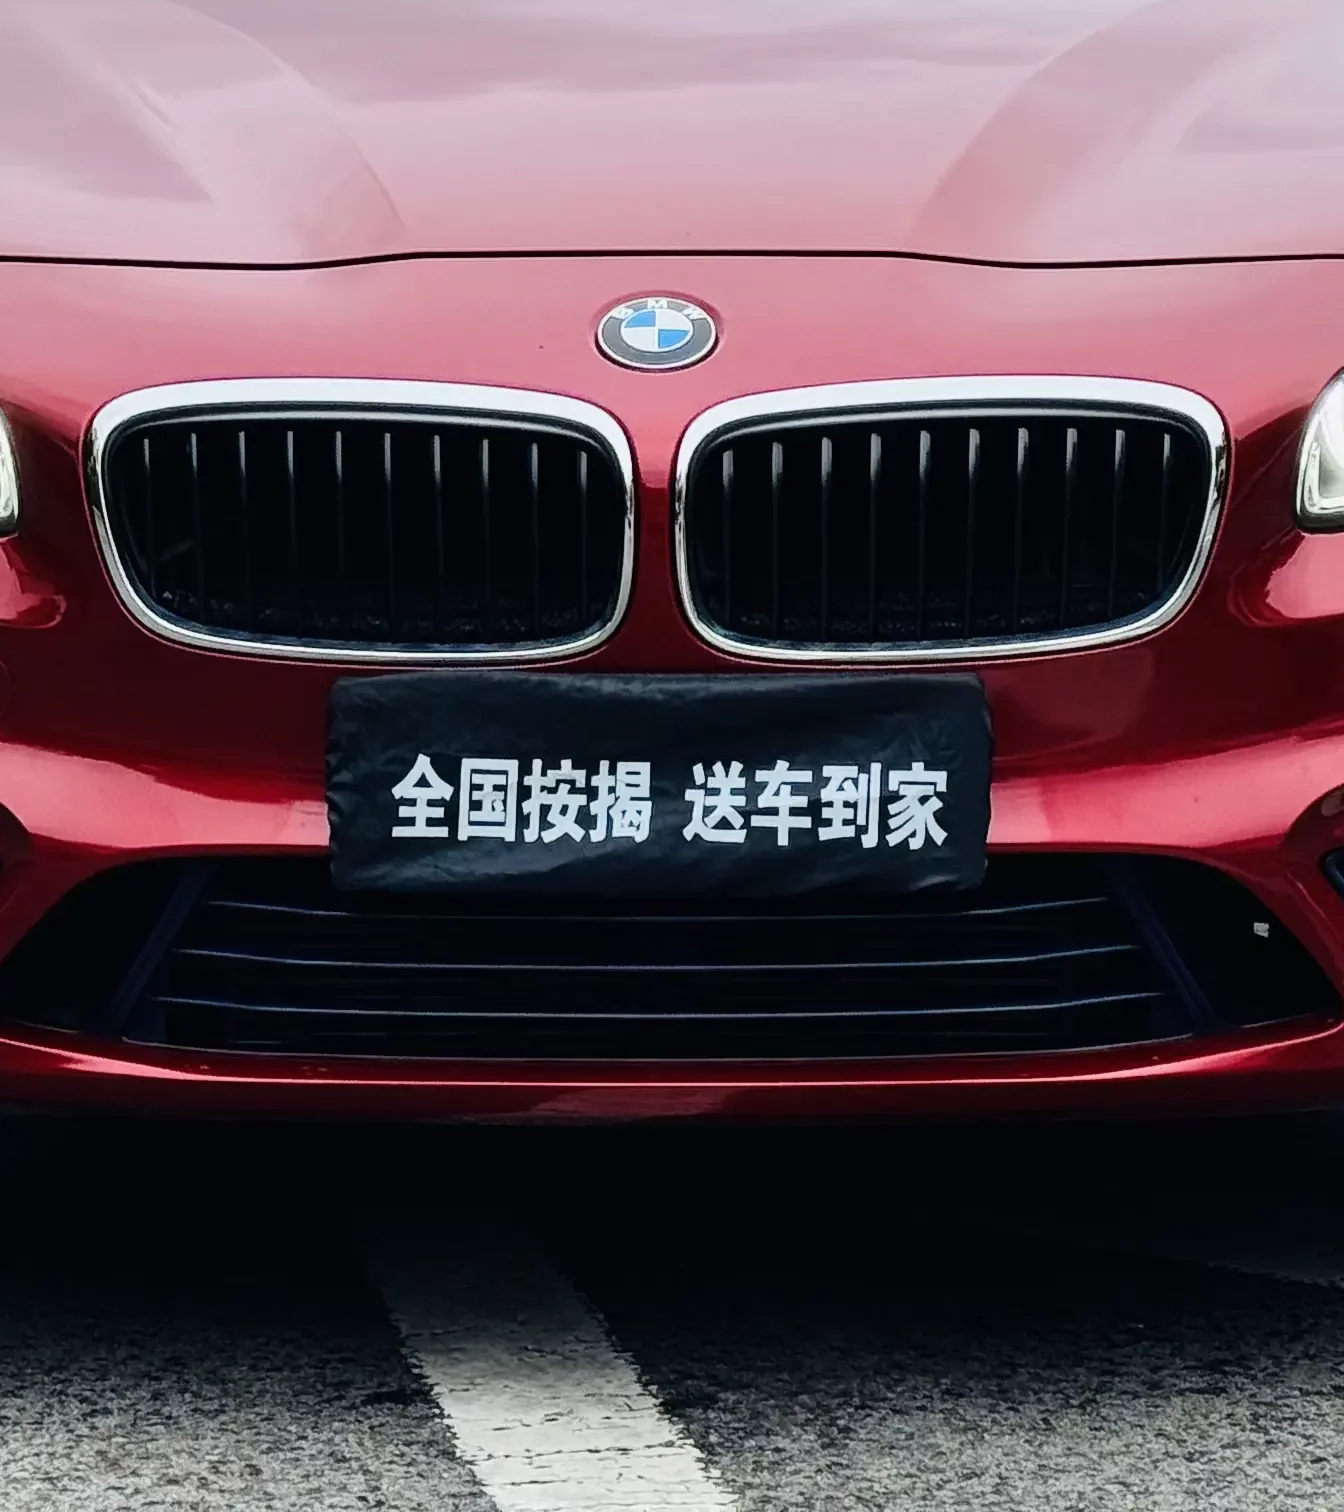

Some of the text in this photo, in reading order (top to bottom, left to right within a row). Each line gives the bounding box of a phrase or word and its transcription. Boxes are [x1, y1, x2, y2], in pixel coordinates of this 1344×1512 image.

[611, 298, 706, 320] BMW
[390, 753, 949, 850] 全国按揭 送车到家
